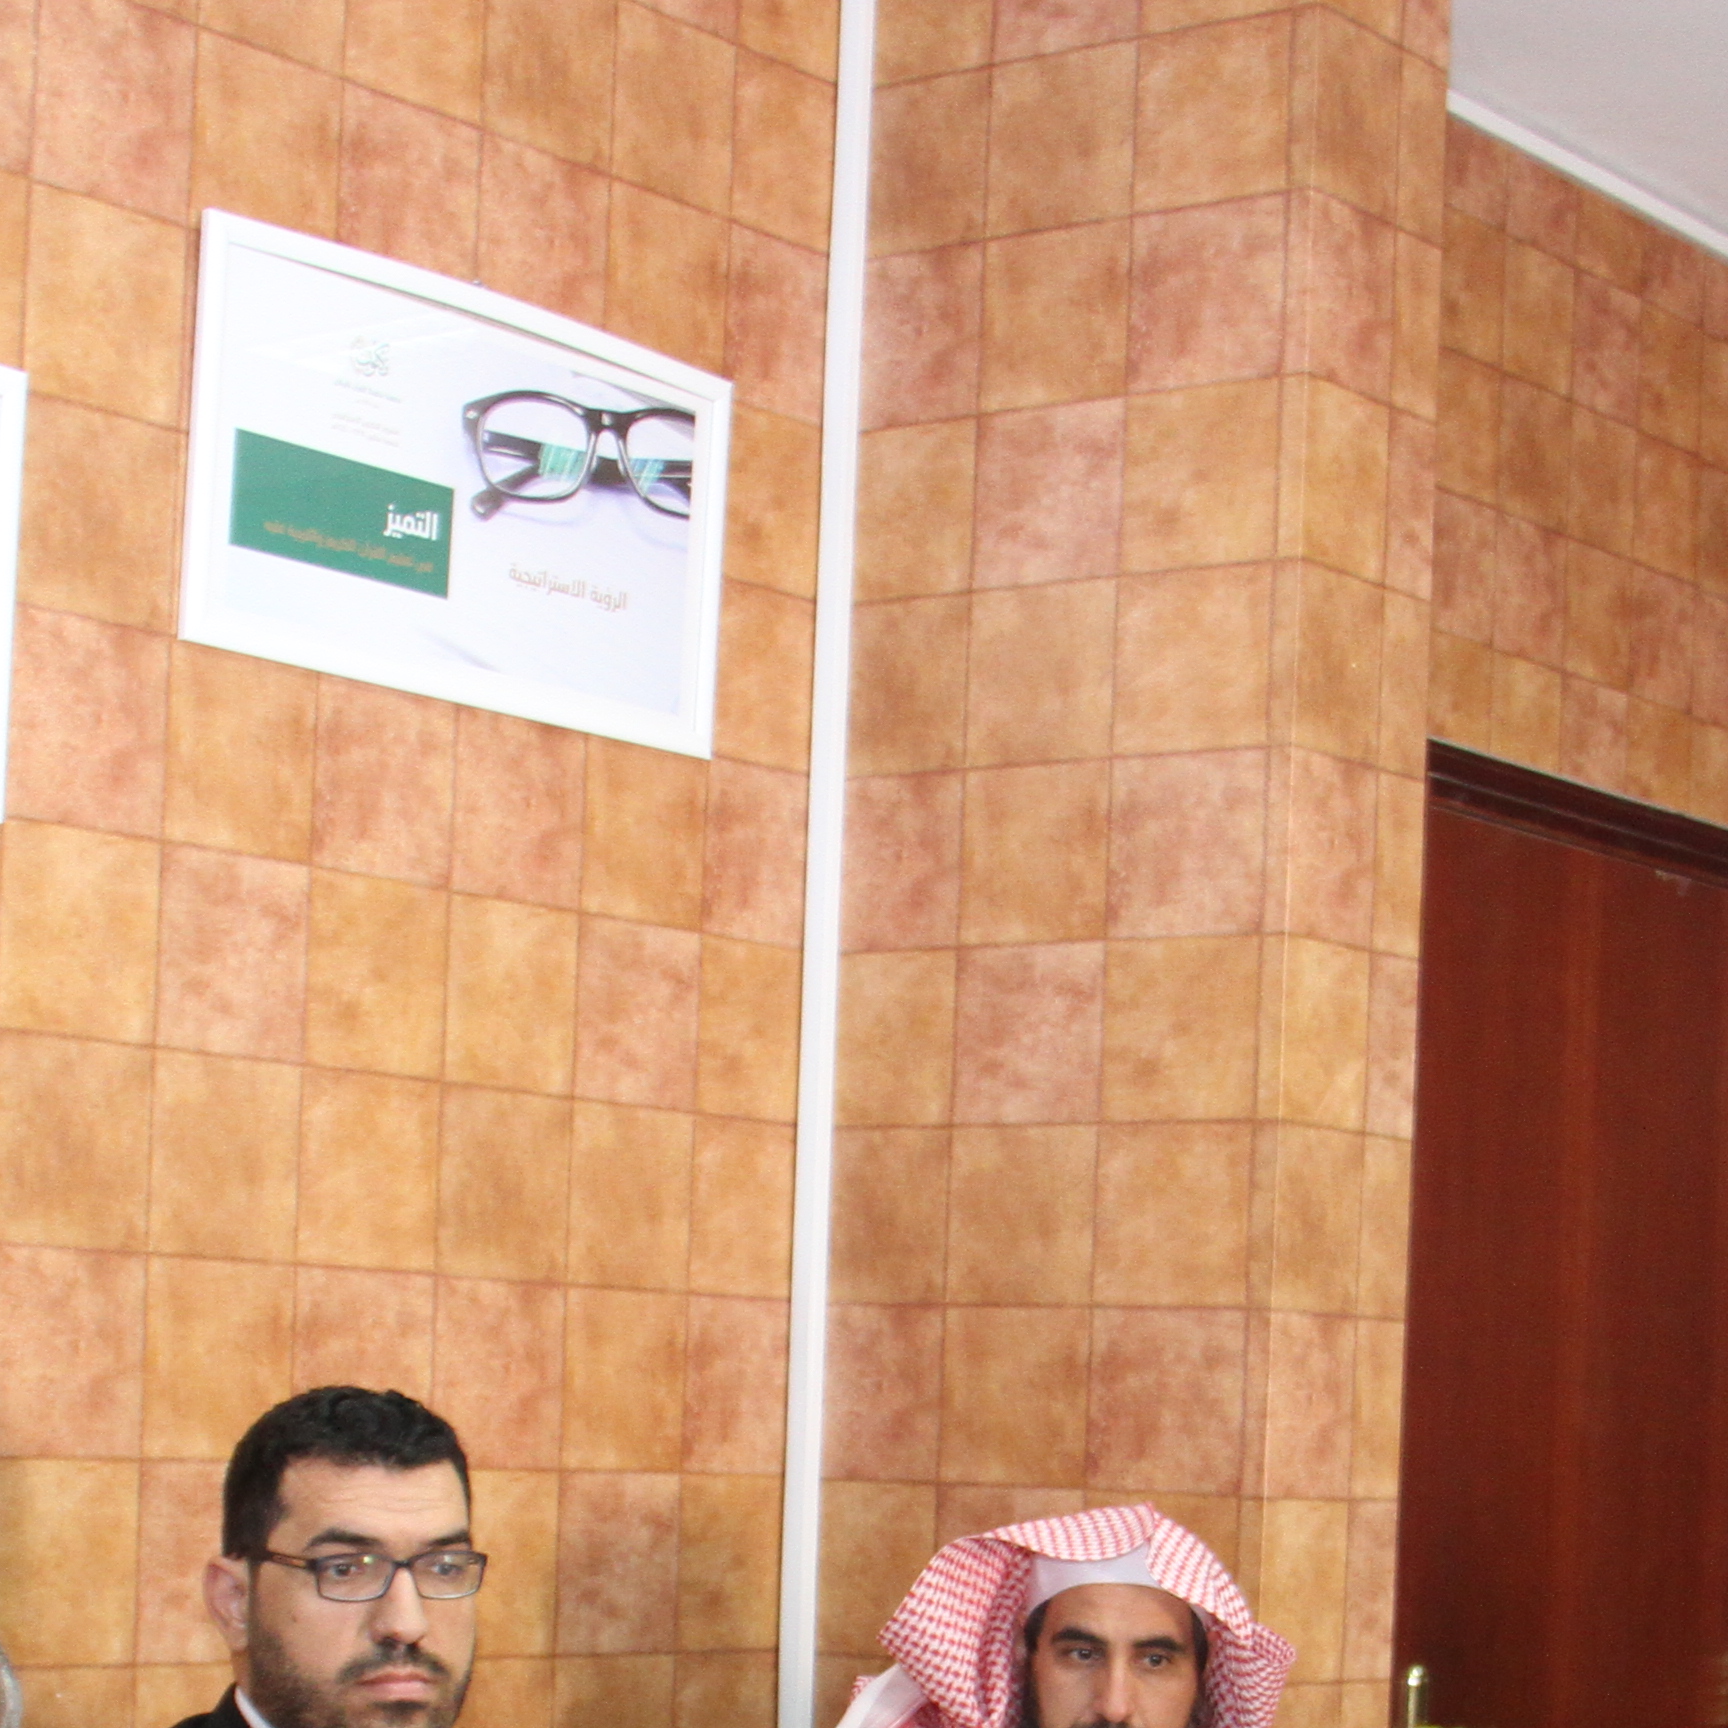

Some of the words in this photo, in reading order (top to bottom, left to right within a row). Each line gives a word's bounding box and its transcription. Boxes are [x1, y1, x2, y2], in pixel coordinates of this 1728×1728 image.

[383, 504, 439, 541] التميز
[508, 562, 586, 599] الاستراتيجية
[589, 584, 627, 612] الرؤية
